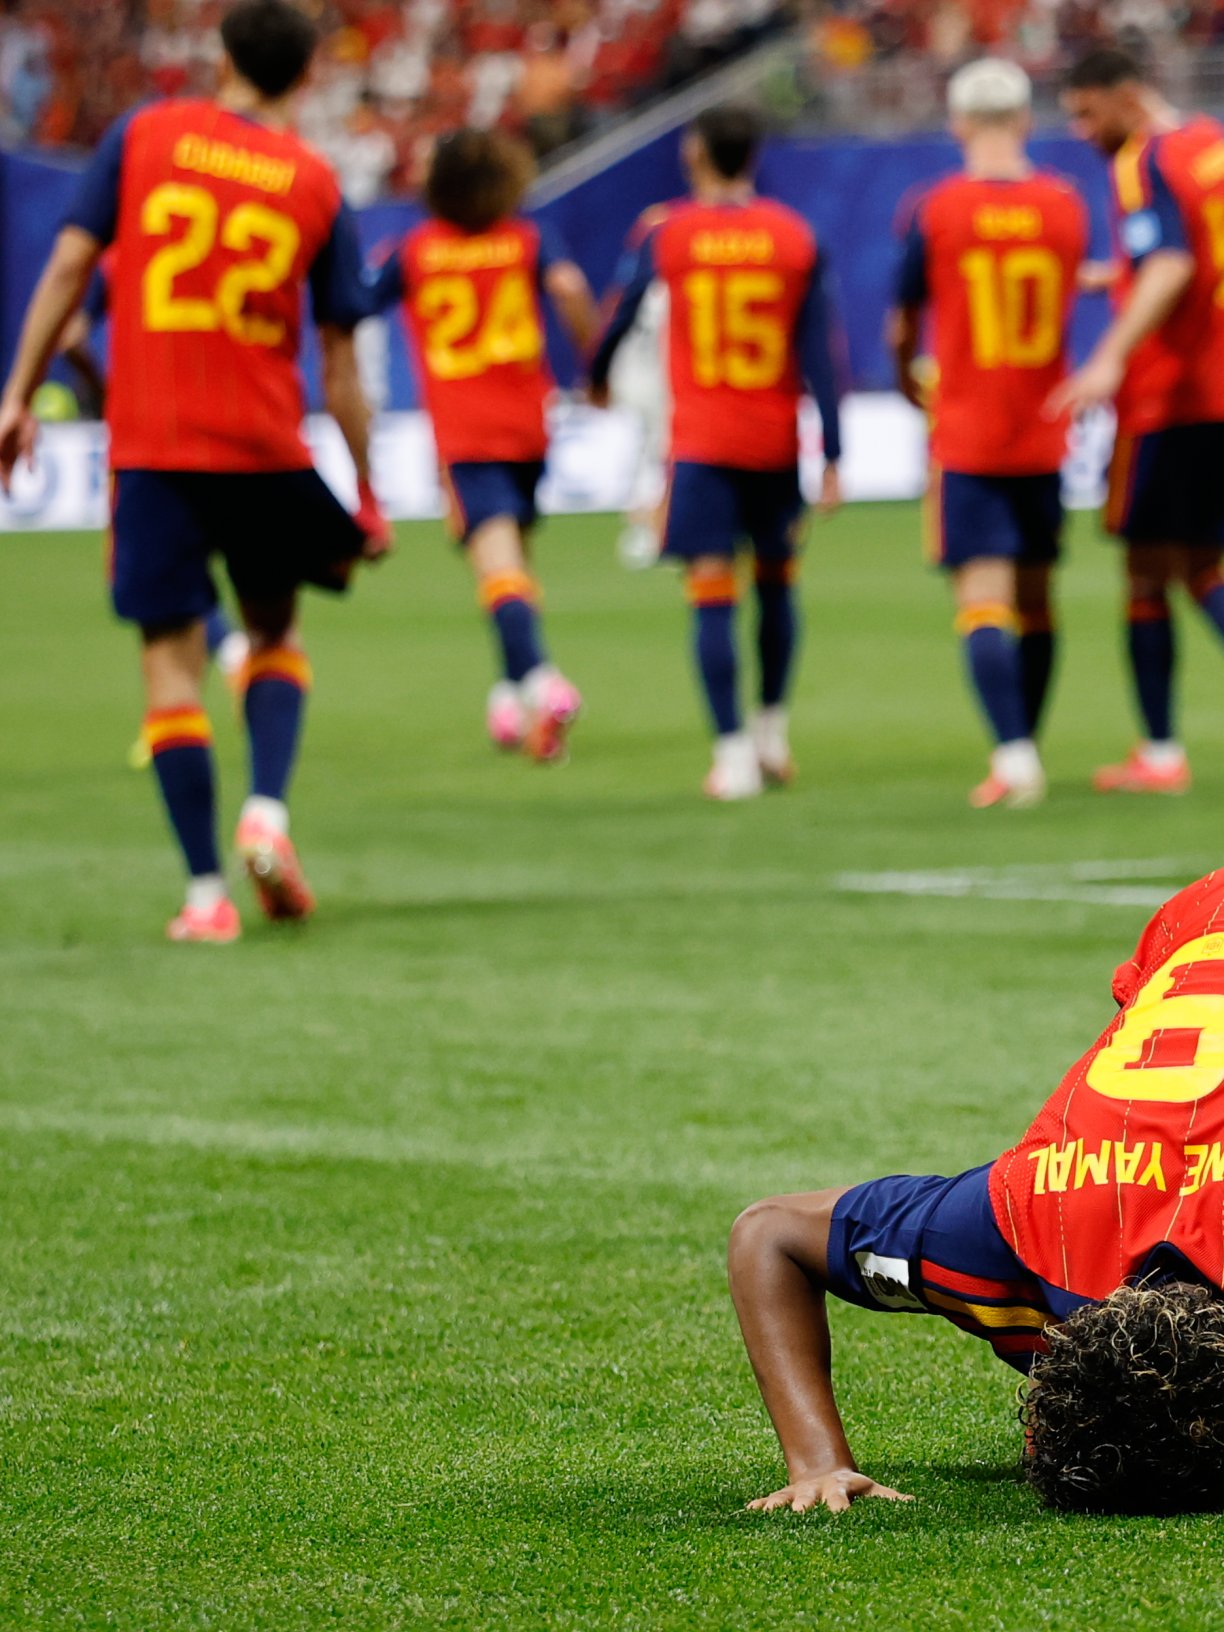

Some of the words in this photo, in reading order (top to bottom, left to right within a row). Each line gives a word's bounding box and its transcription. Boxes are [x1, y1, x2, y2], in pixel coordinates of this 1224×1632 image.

[142, 183, 299, 345] 22
[959, 248, 1062, 370] 10
[417, 268, 544, 380] 24
[683, 271, 787, 390] 15
[1027, 1137, 1167, 1195] YAMAL
